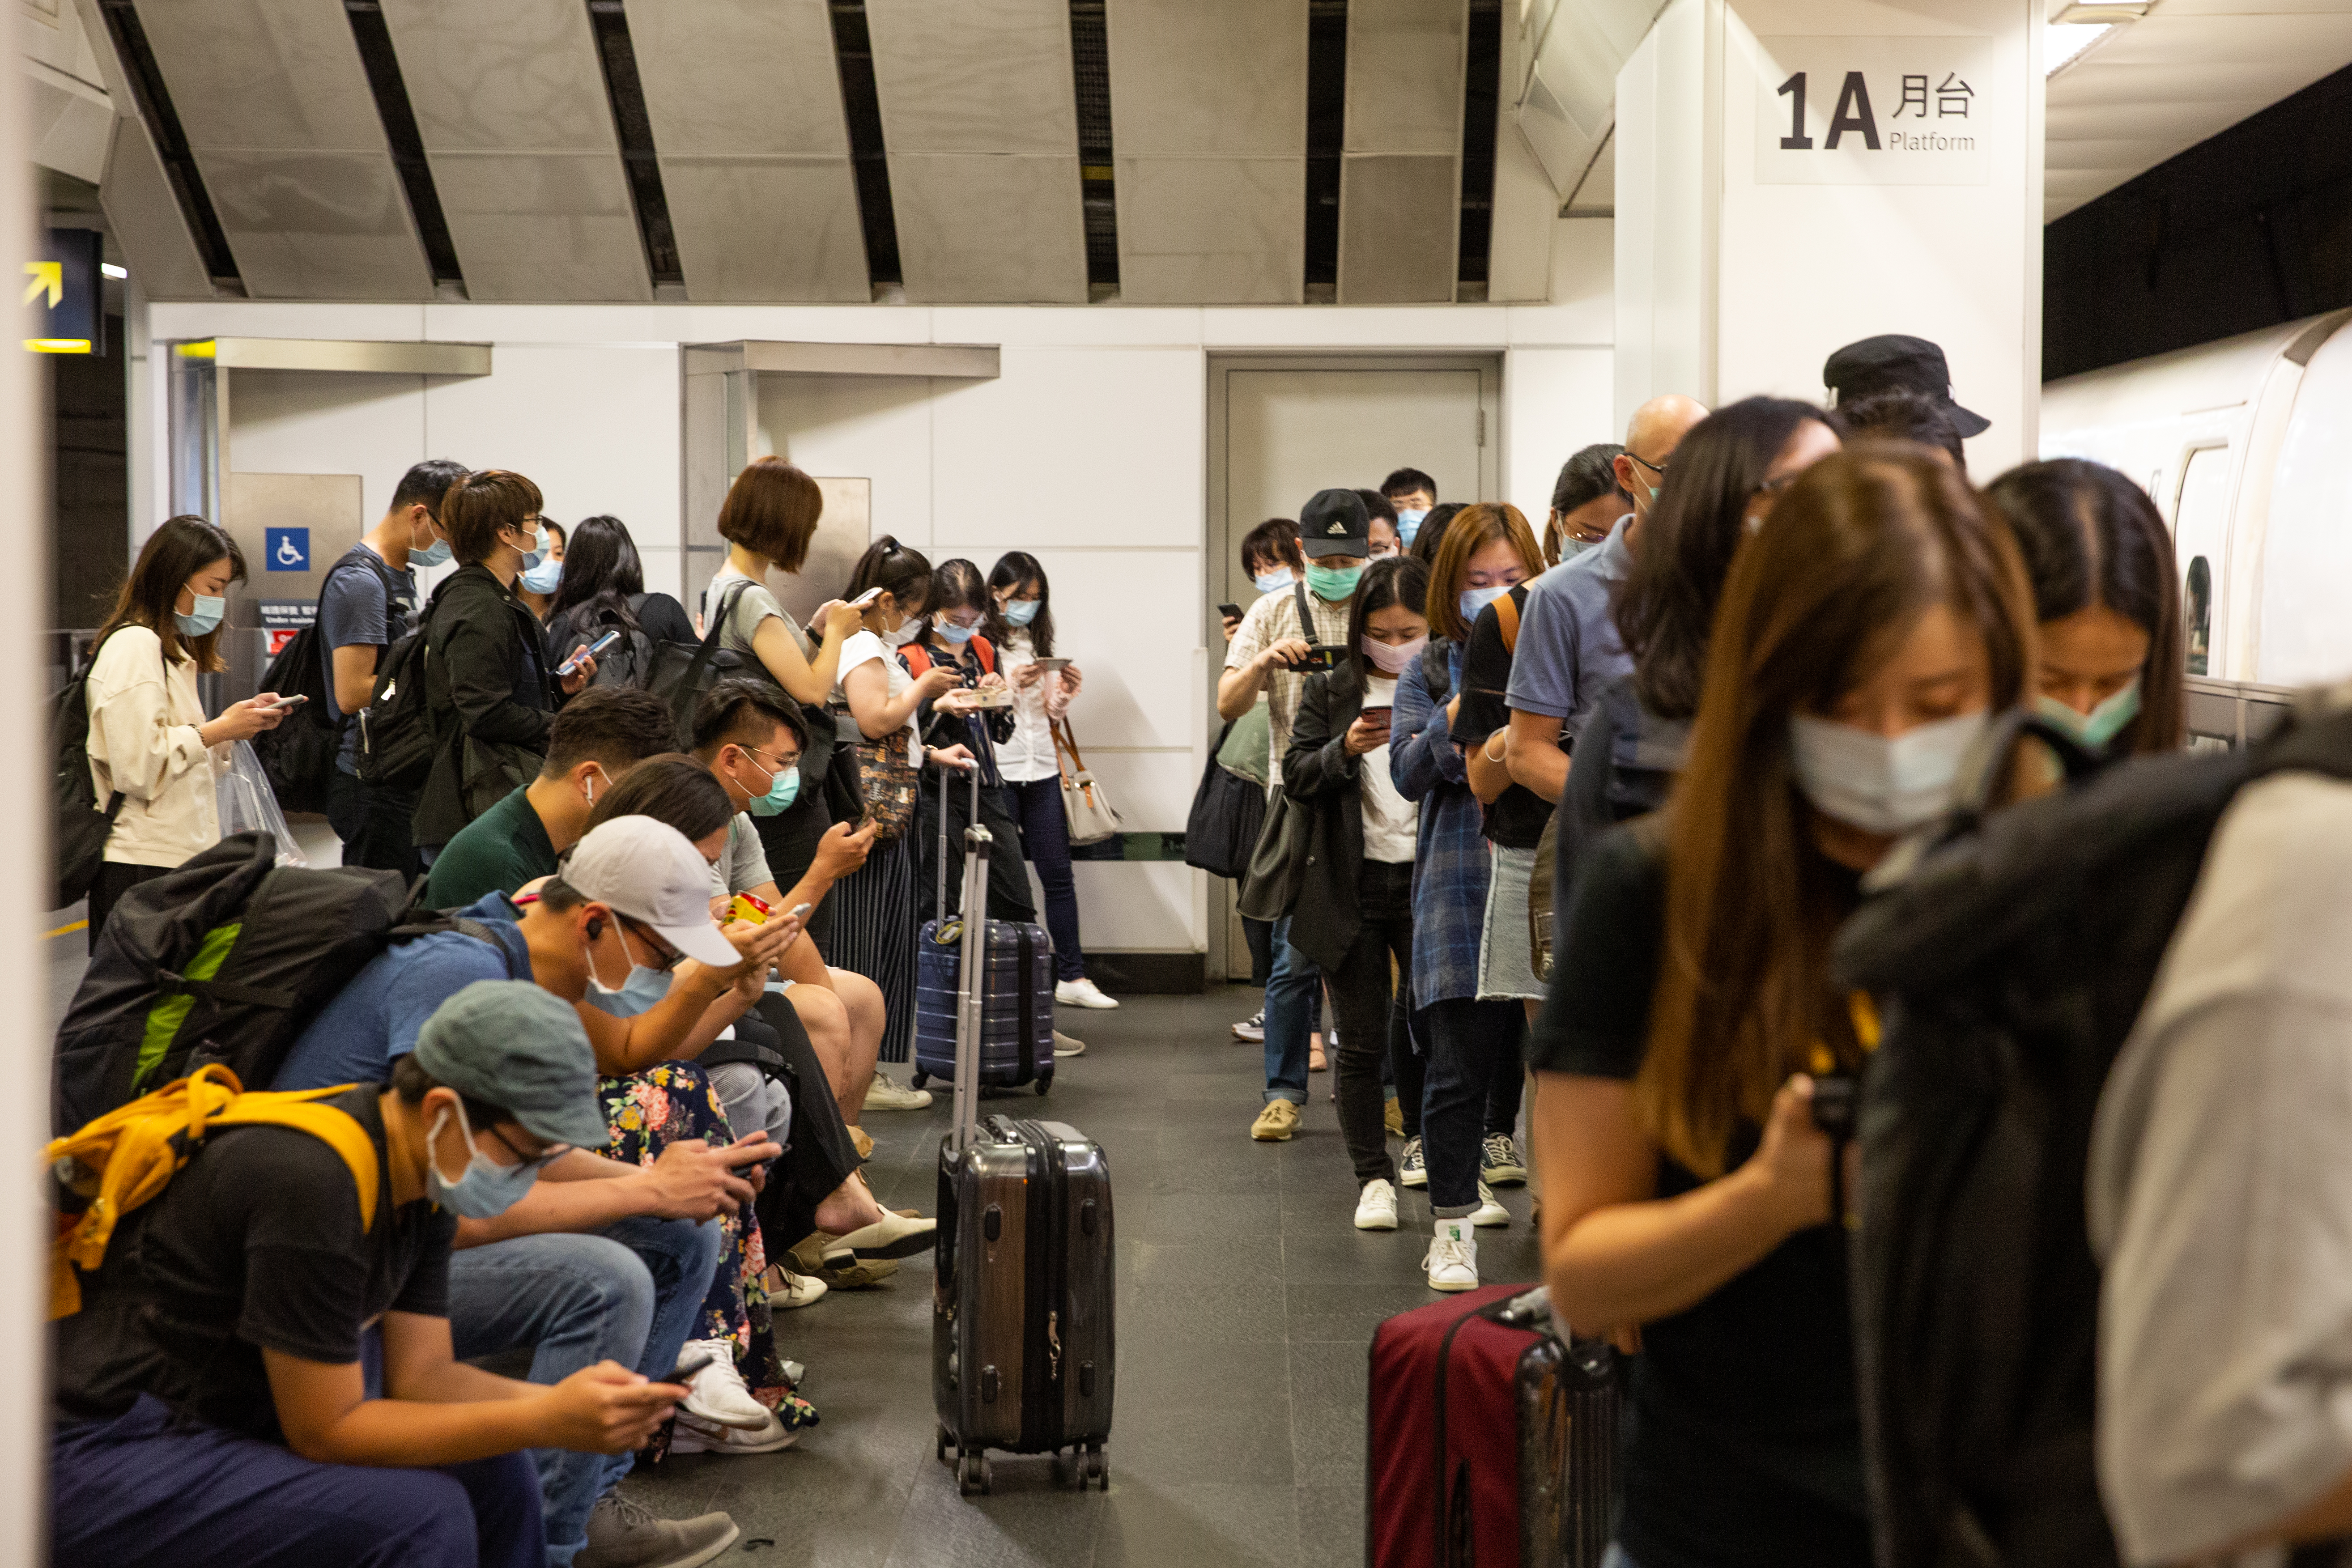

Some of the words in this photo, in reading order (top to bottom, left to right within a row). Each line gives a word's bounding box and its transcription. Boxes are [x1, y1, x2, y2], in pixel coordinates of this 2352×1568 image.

[1777, 71, 1882, 150] 1A
[1892, 72, 1974, 118] 月台
[1890, 132, 1975, 150] Platform
